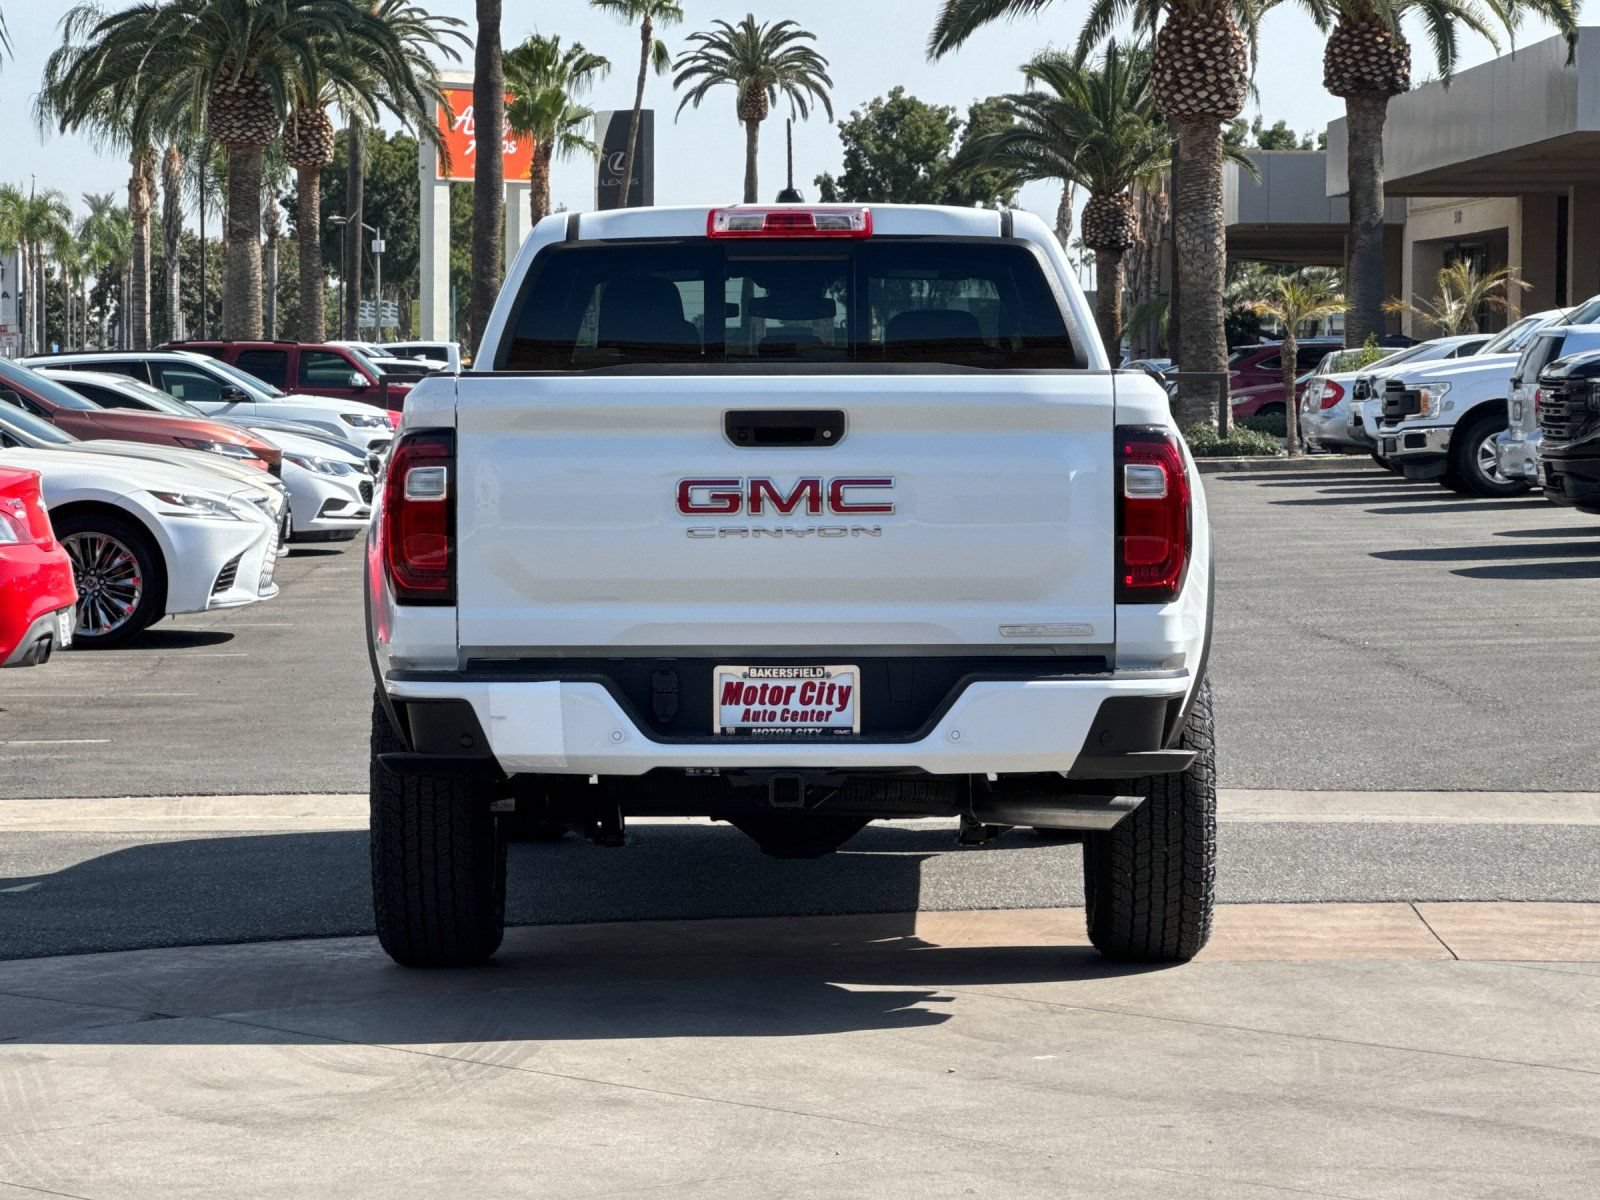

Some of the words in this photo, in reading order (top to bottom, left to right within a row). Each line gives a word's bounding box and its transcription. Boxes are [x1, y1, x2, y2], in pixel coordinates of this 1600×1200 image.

[601, 178, 639, 186] LEXS
[675, 476, 896, 516] GMC
[686, 525, 882, 539] CANYON
[749, 668, 824, 678] BAKERSFIELD
[721, 681, 796, 706] Motor
[799, 680, 852, 712] City
[741, 708, 777, 723] Auto
[780, 708, 833, 722] Center
